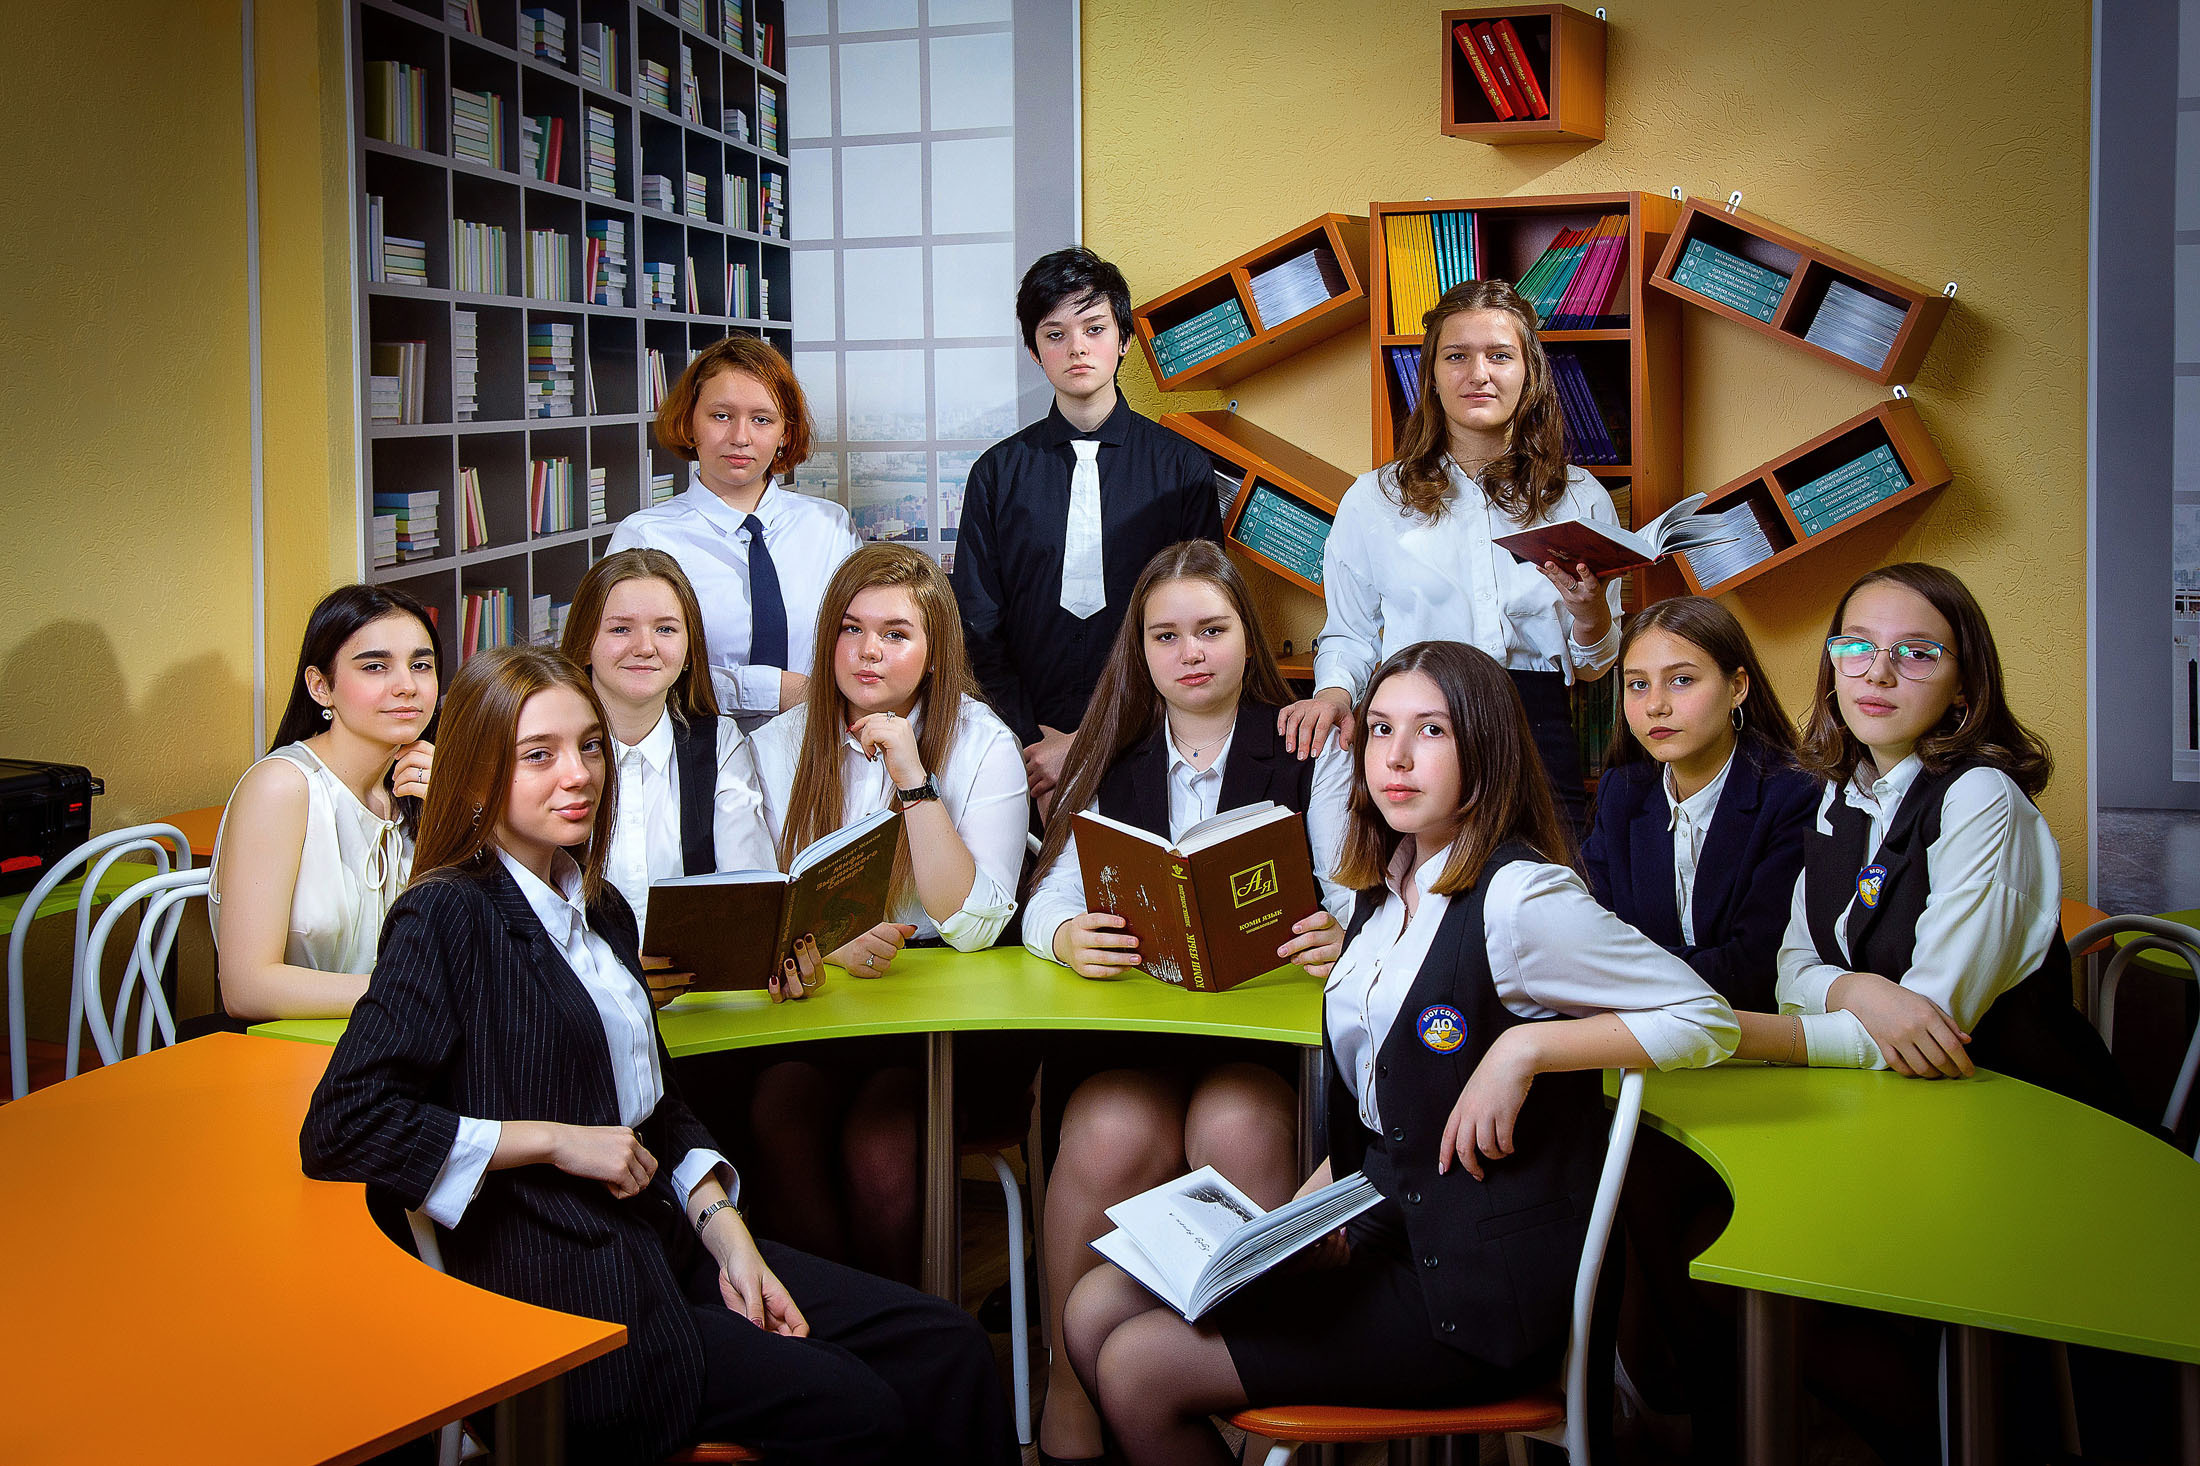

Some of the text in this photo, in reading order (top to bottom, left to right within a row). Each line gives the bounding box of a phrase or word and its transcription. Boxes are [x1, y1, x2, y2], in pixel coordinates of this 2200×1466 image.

[1240, 909, 1283, 931] КОМИ ЯЗЫК
[1186, 933, 1199, 960] ЯЗЫК
[1192, 961, 1205, 989] КОМИ
[1423, 1009, 1459, 1022] МОУ СОШ
[1430, 1018, 1453, 1034] 40
